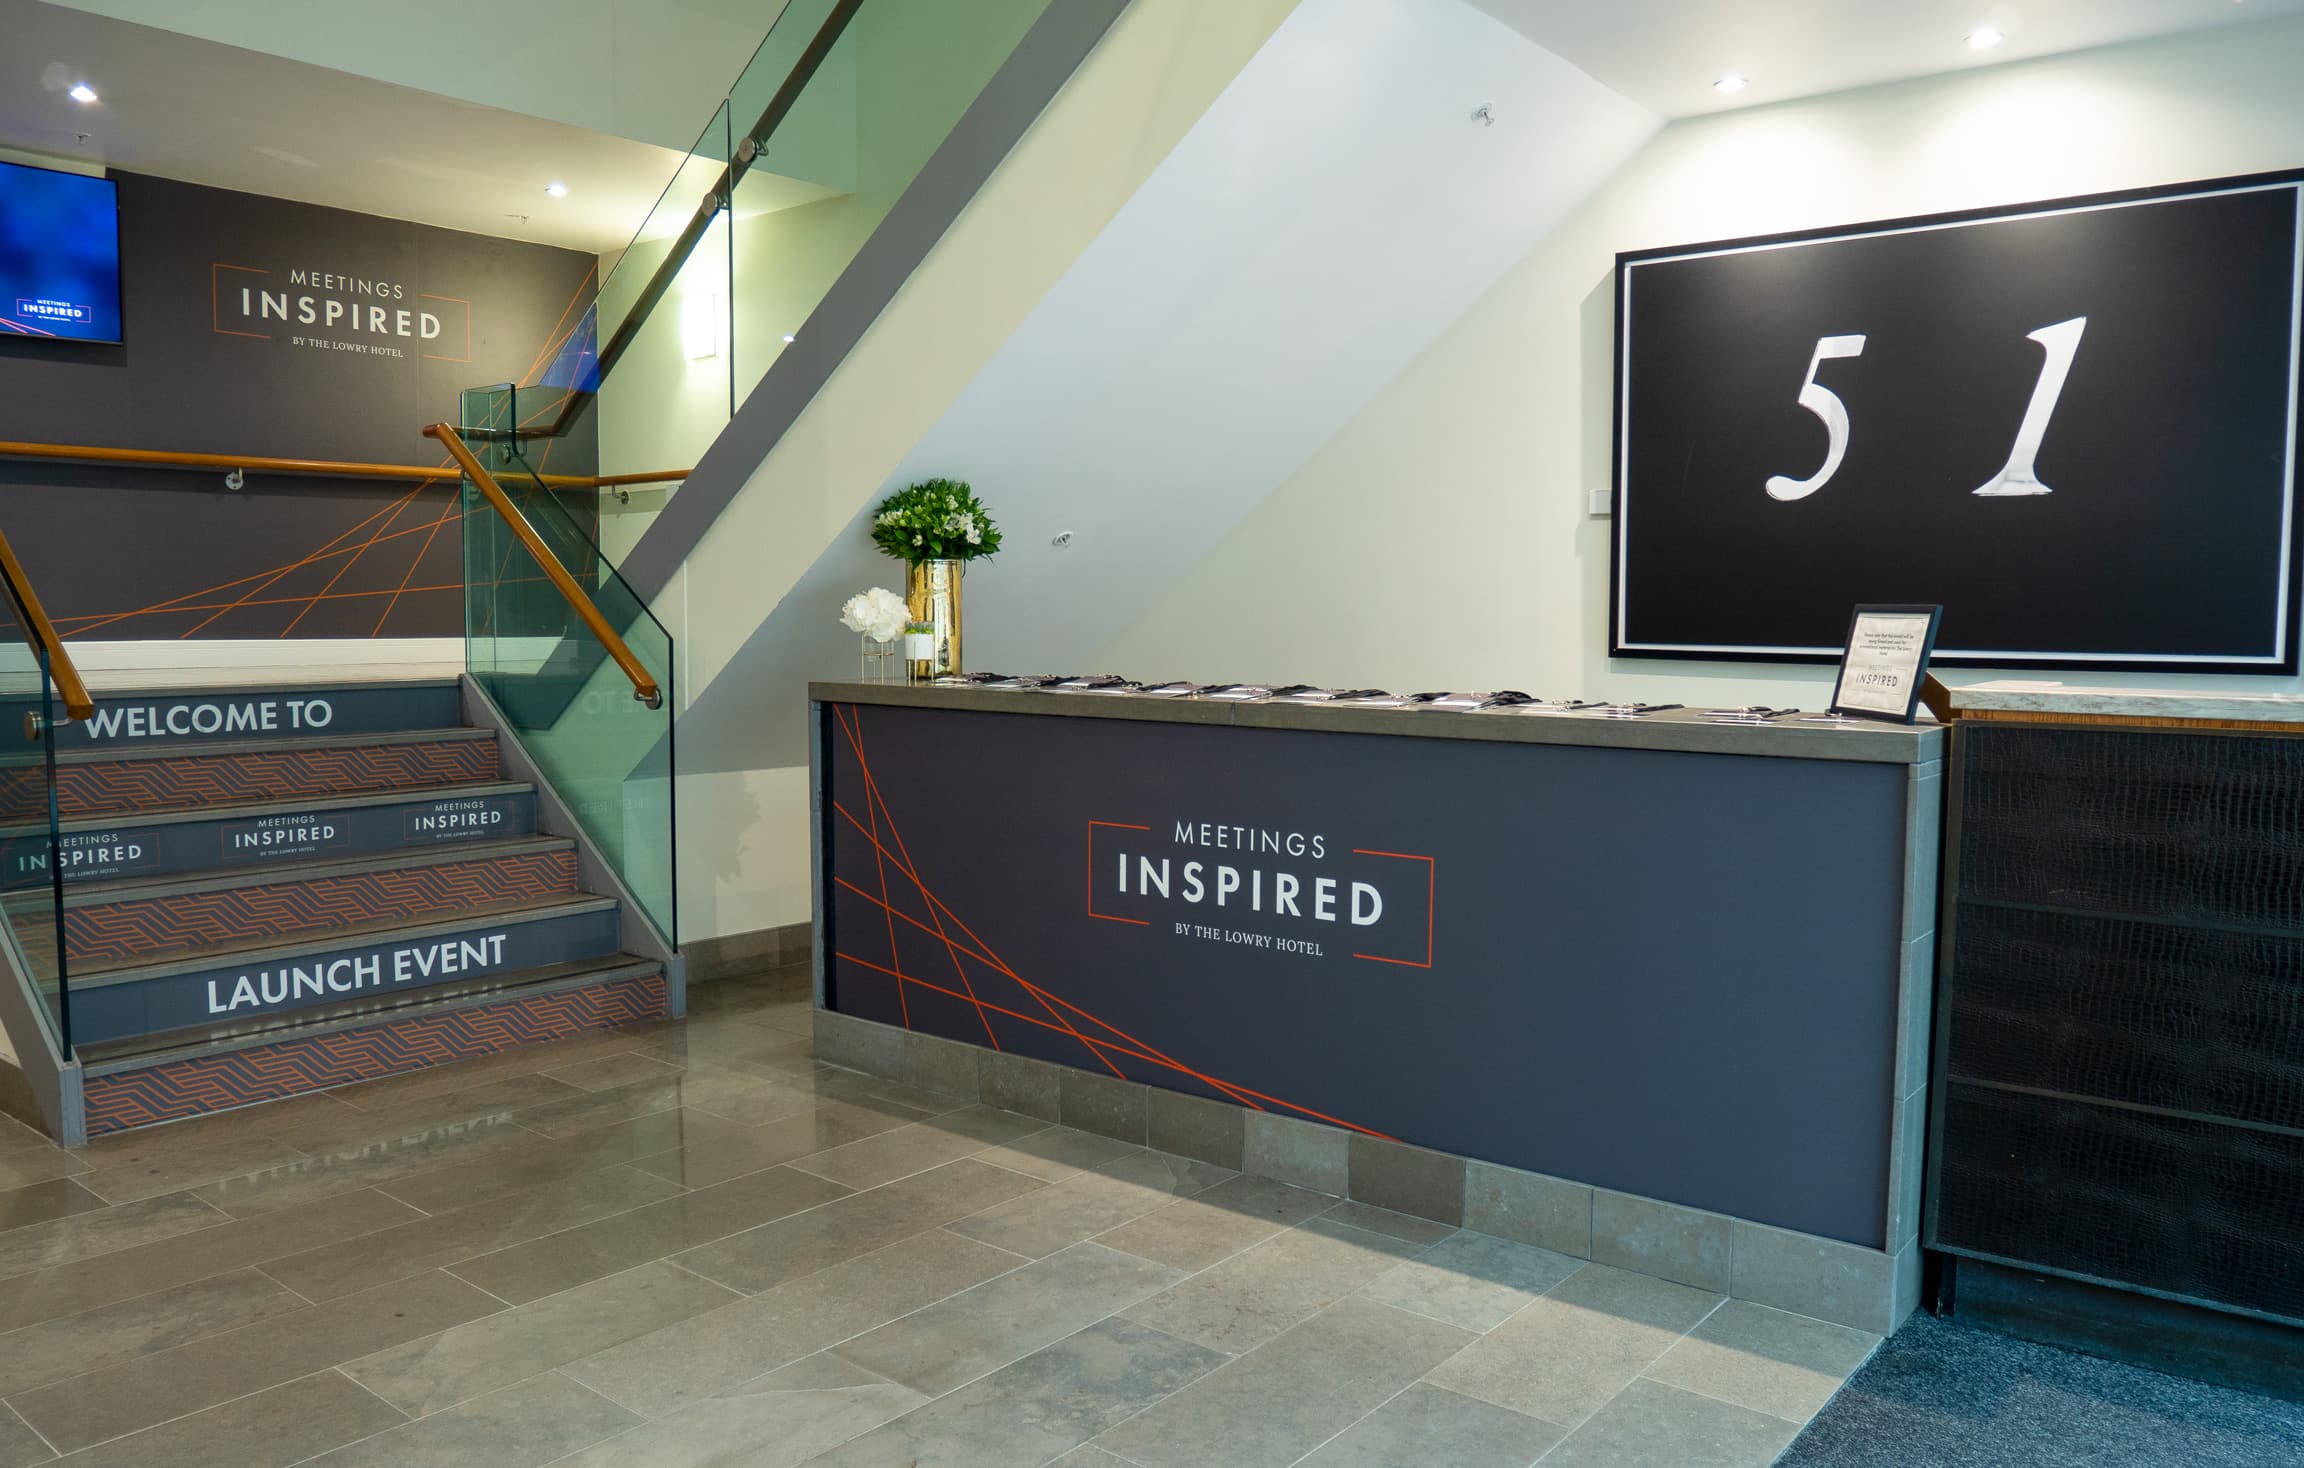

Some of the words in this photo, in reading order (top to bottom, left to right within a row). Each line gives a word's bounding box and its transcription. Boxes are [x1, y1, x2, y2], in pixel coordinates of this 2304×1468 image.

[290, 268, 403, 299] MEETINGS
[23, 304, 83, 318] INSPIRED
[242, 288, 441, 339] INSPIRED
[292, 336, 306, 346] BY
[308, 338, 329, 349] THE
[332, 341, 368, 353] LOWRY
[371, 346, 404, 358] HOTEL
[1855, 672, 1898, 687] INSPIRED
[84, 702, 278, 739] WELCOME
[286, 699, 333, 729] TO
[435, 800, 485, 812] MEETINGS
[258, 815, 316, 827] MEETINGS
[415, 811, 501, 831] INSPIRED
[235, 825, 335, 848] INSPIRED
[1175, 820, 1326, 859] MEETINGS
[19, 845, 142, 872] INSPIRED
[1118, 853, 1383, 926] INSPIRED
[1175, 922, 1191, 936] BY
[1194, 925, 1221, 941] THE
[1225, 930, 1272, 948] LOWRY
[1276, 937, 1324, 957] HOTEL
[208, 954, 380, 1014] LAUNCH
[393, 934, 506, 982] EVENT
